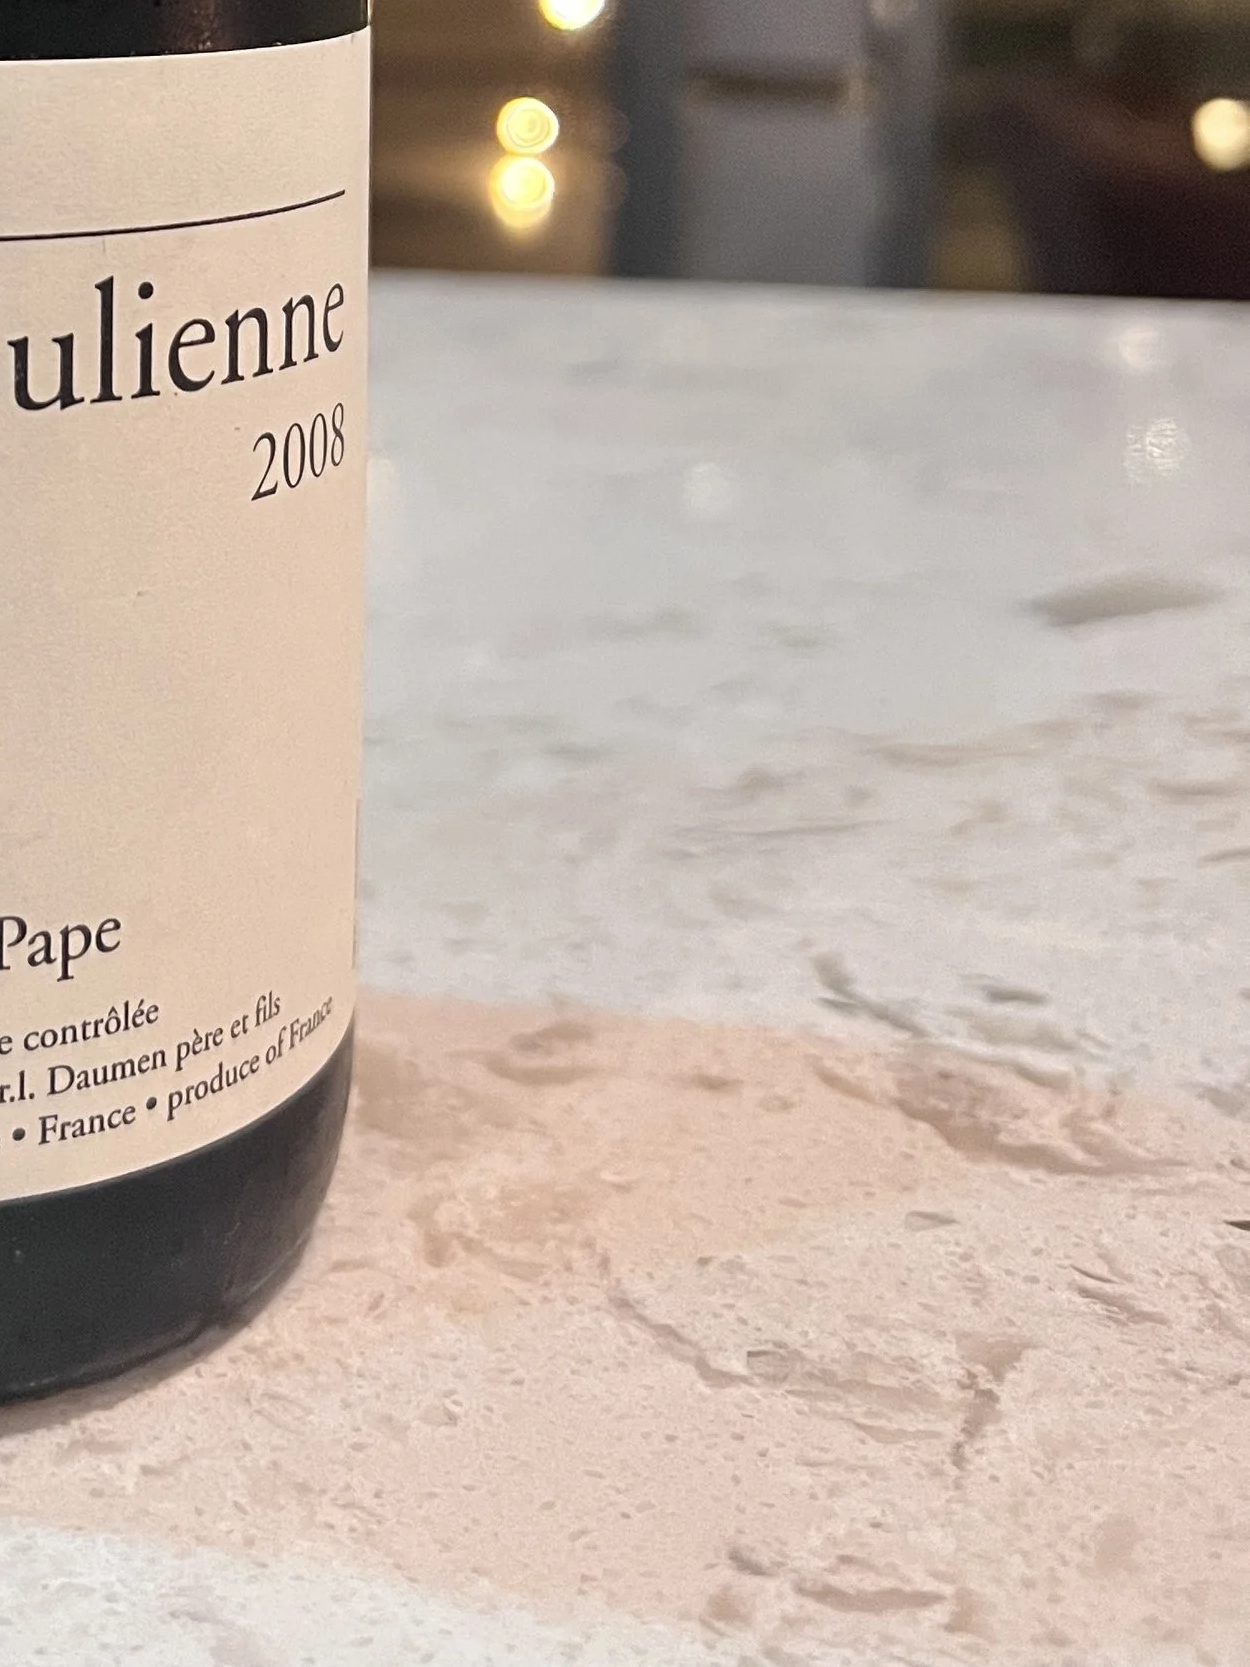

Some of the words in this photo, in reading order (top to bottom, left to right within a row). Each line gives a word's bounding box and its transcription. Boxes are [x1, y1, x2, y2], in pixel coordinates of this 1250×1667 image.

[252, 402, 346, 502] 2008
[23, 998, 159, 1052] contrôlée
[38, 1104, 136, 1145] France
[166, 1053, 260, 1122] produce
[265, 1026, 287, 1065] of
[288, 995, 333, 1051] France
[47, 1049, 167, 1096] Daumen
[175, 1027, 224, 1072] père
[230, 1013, 249, 1039] et
[254, 989, 281, 1028] fils
